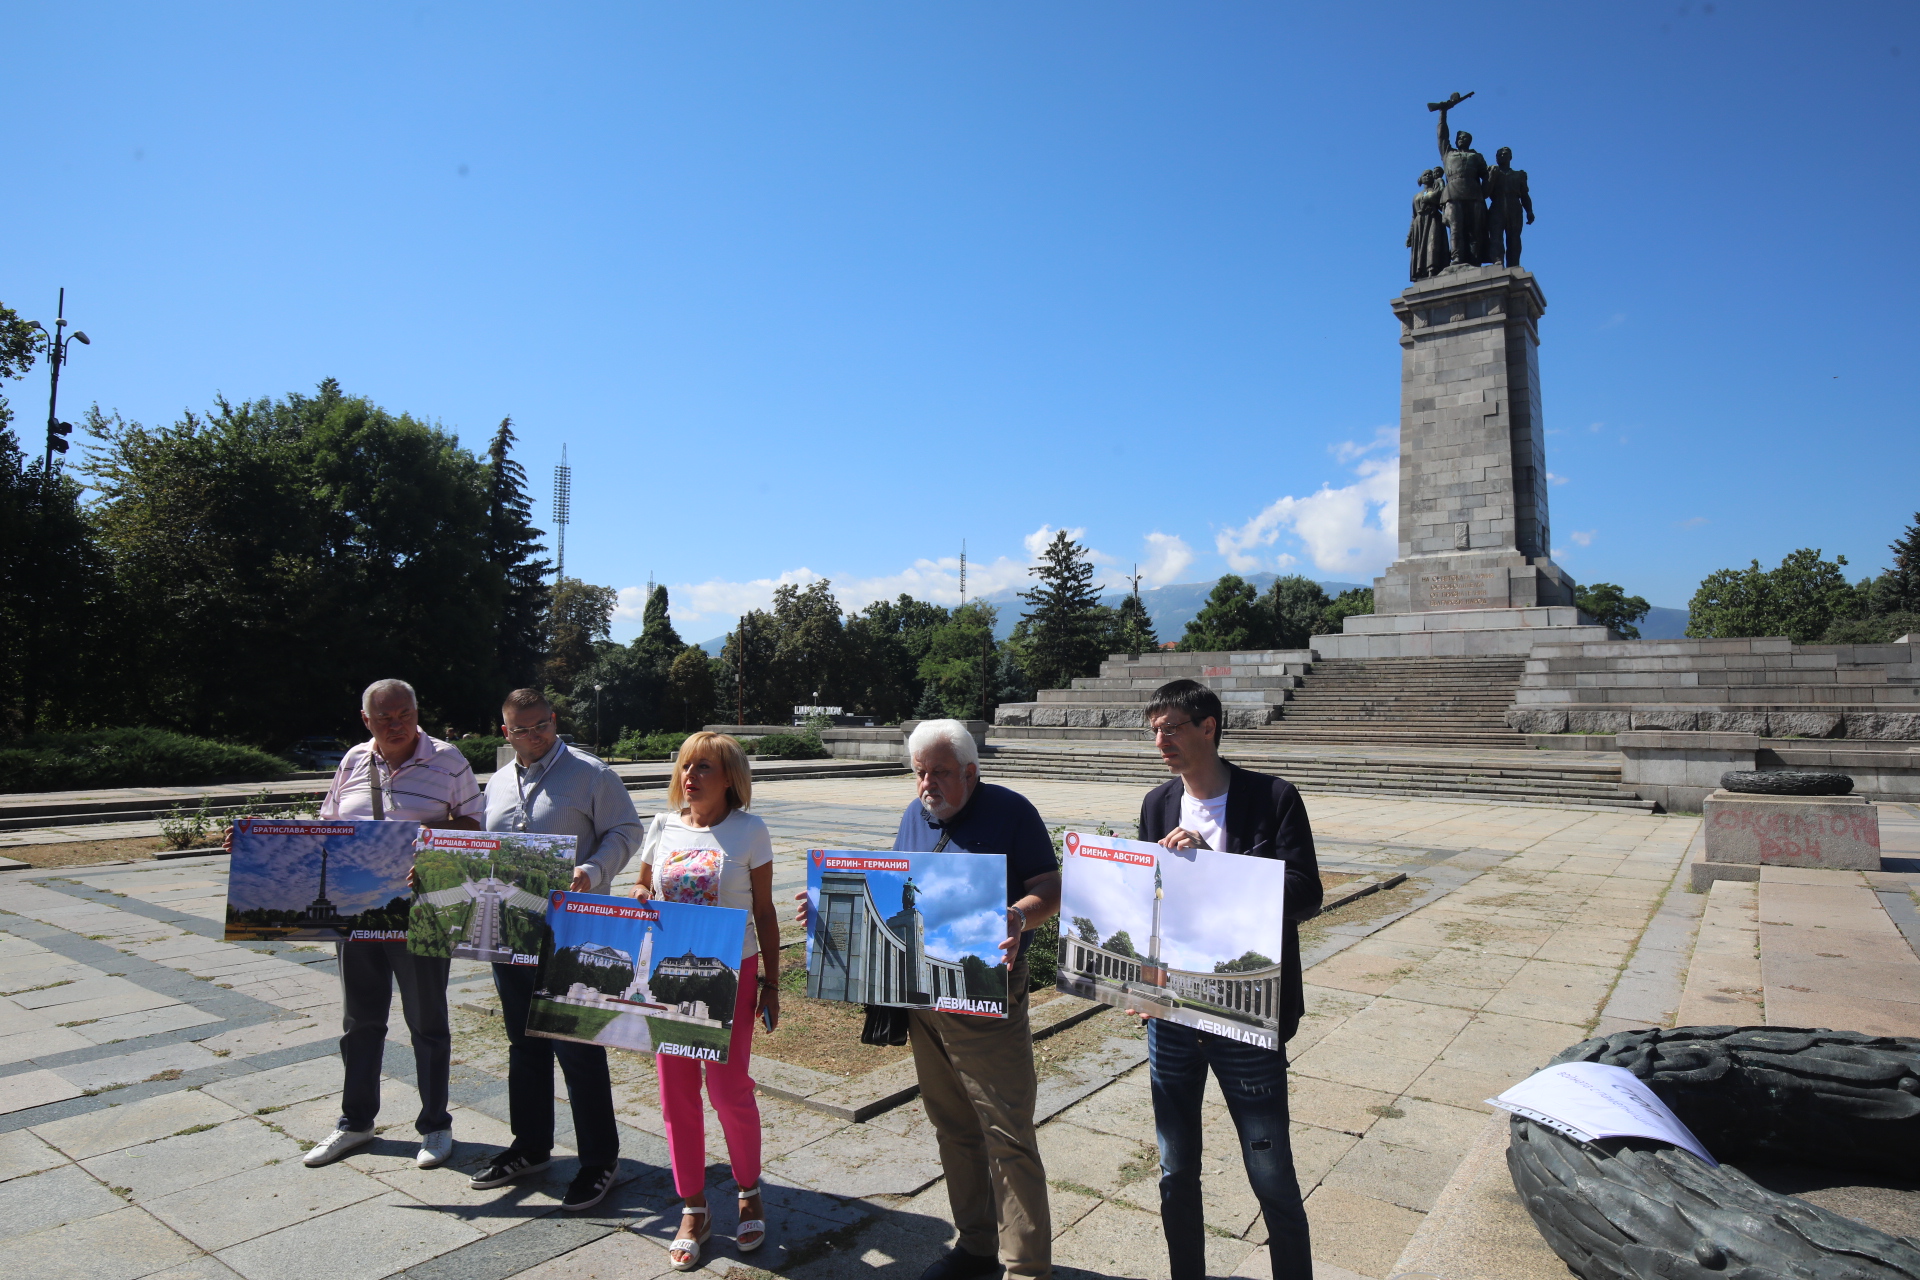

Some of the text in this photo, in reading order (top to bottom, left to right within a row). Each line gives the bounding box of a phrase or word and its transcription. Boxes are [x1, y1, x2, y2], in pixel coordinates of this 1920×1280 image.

[252, 825, 354, 835] БРАТИСЛАВА- СЛОВАКИЯ
[434, 838, 497, 849] ВАРШАВА- ПОЛША
[1081, 847, 1151, 864] ВИЕНА- АВСТРИЯ
[826, 859, 908, 869] БЕРЛИН- ГЕРМАНИЯ
[566, 903, 658, 920] БУДАПЕЩА- УНГАРИЯ
